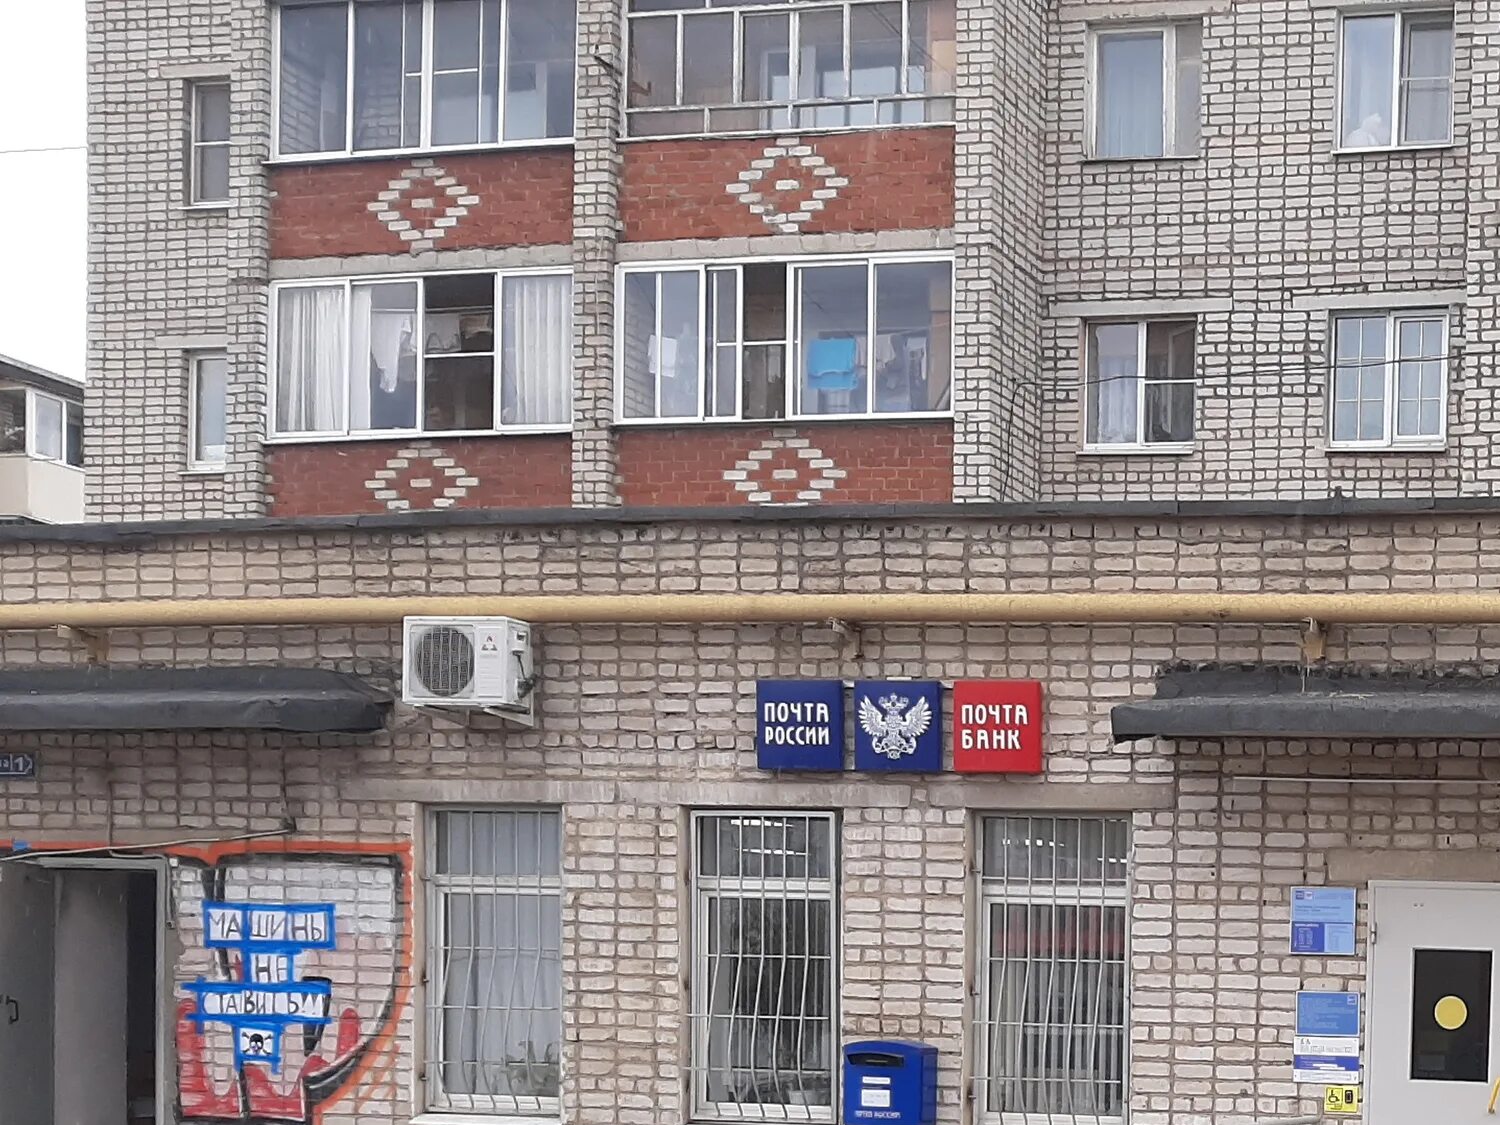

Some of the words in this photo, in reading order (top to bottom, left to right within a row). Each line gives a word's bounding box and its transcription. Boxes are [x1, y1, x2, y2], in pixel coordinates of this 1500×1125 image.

[764, 702, 829, 723] ПОЧТА
[961, 704, 1028, 725] ПОЧТА
[765, 726, 830, 746] РОССИИ
[961, 728, 1022, 750] БАНК
[254, 953, 288, 984] НЕ
